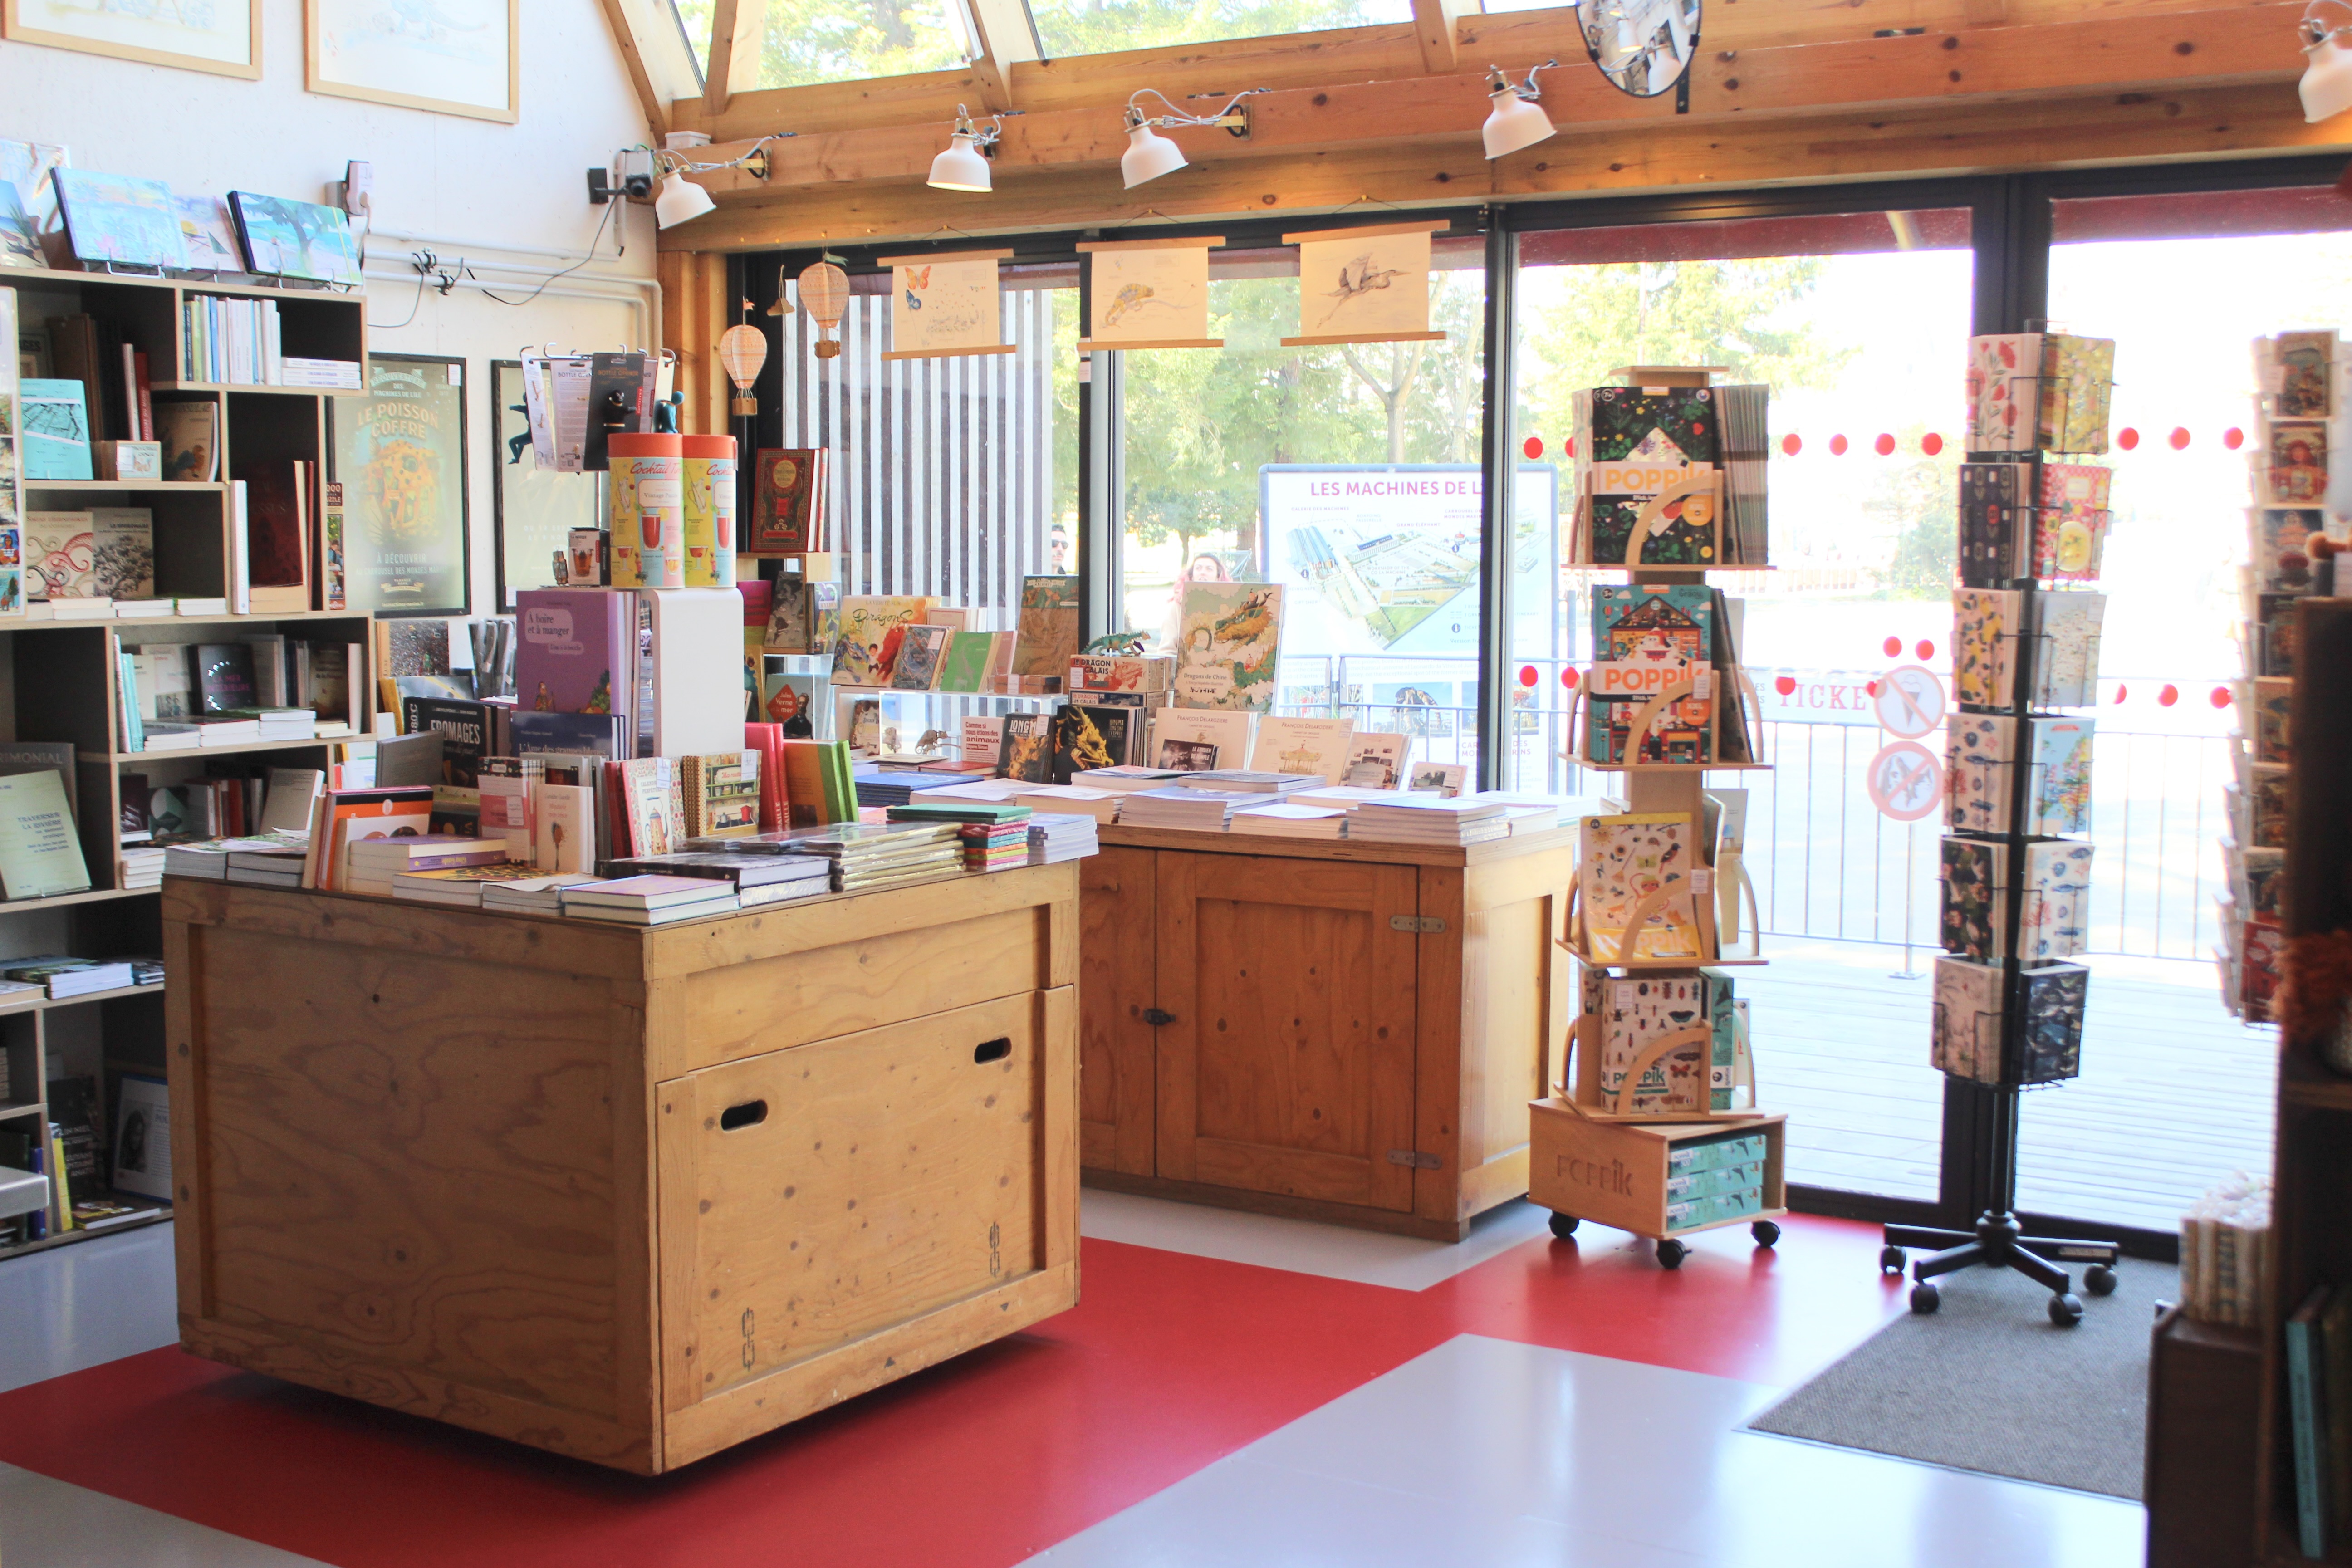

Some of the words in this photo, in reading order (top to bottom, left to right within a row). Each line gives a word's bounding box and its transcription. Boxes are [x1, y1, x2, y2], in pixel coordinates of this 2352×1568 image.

[357, 407, 372, 426] LE
[377, 402, 438, 429] POISSON
[371, 420, 425, 439] COFFRE
[630, 462, 669, 474] Cocktail
[1311, 482, 1340, 495] LES
[1346, 482, 1439, 495] MACHINES
[1445, 481, 1466, 495] DE
[377, 552, 382, 564] À
[385, 551, 426, 564] DÉCOUVRIR
[395, 567, 405, 575] DES
[536, 613, 554, 623] boire
[528, 626, 534, 634] et
[543, 627, 569, 638] manger
[1081, 659, 1111, 667] DRAGON
[1177, 715, 1199, 723] FRANÇOIS
[1282, 721, 1303, 730] FRANÇOIS
[431, 720, 480, 745] FROMAGES
